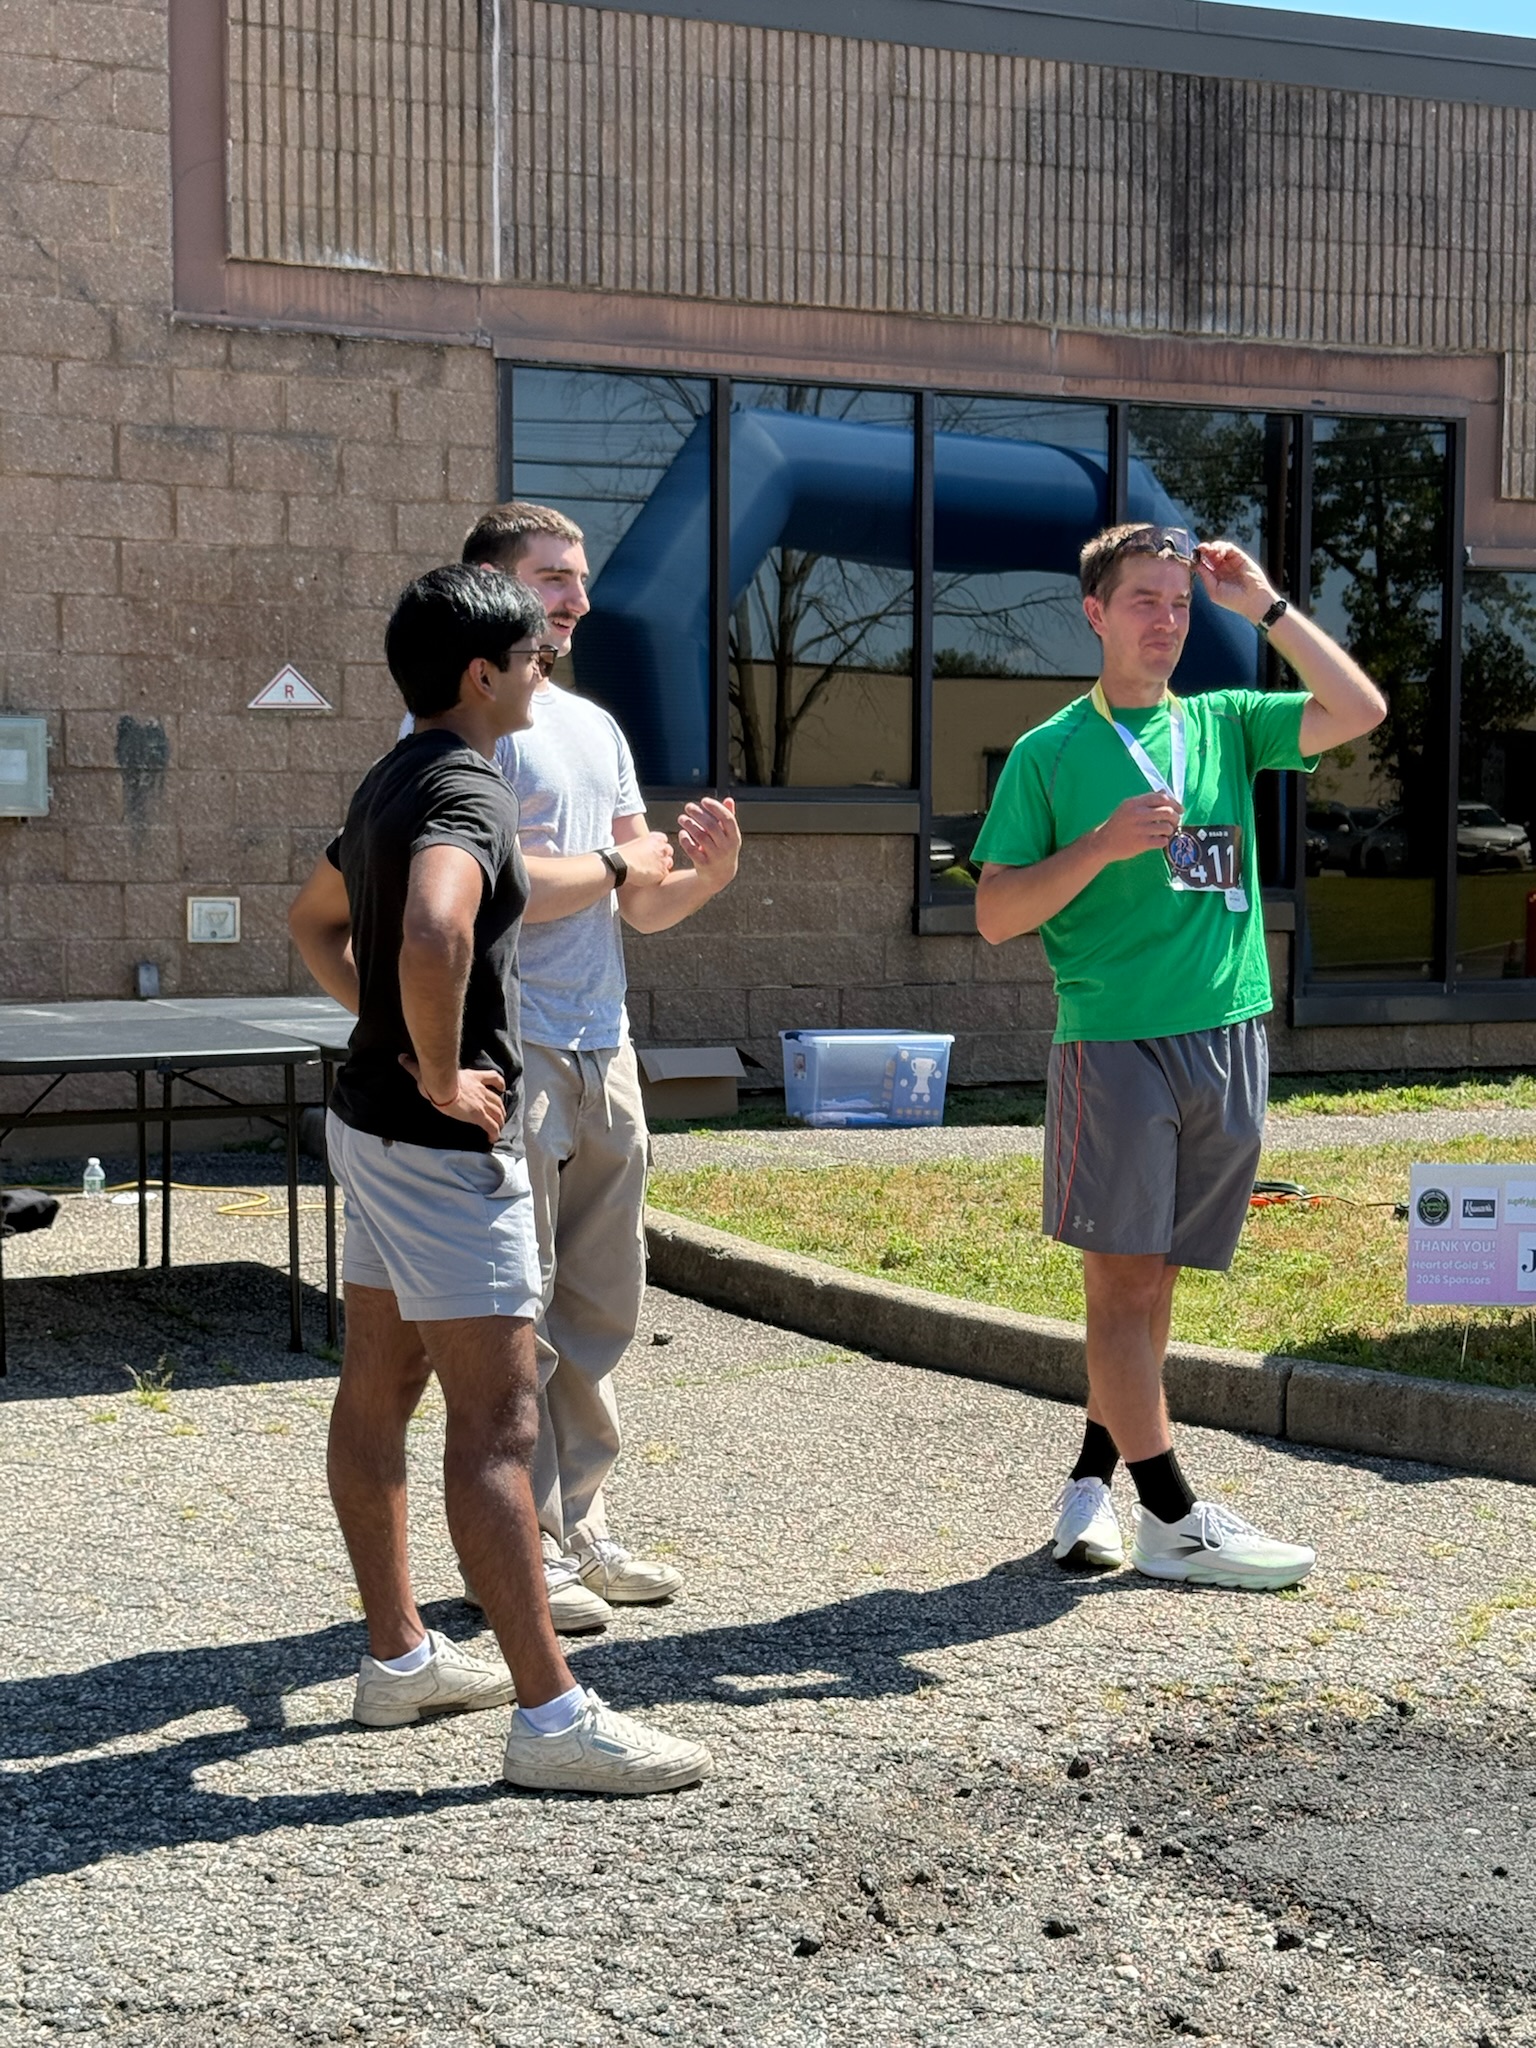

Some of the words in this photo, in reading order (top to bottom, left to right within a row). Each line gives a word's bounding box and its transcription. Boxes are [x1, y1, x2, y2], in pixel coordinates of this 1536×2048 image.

[284, 685, 295, 699] R
[1413, 1240, 1459, 1252] THANK
[1463, 1240, 1496, 1253] YOU!
[1412, 1260, 1441, 1269] Heart
[1443, 1260, 1454, 1269] of
[1454, 1260, 1479, 1270] Gold
[1482, 1261, 1496, 1270] 5K
[1416, 1274, 1441, 1285] 2026
[1443, 1275, 1491, 1287] Sponsors
